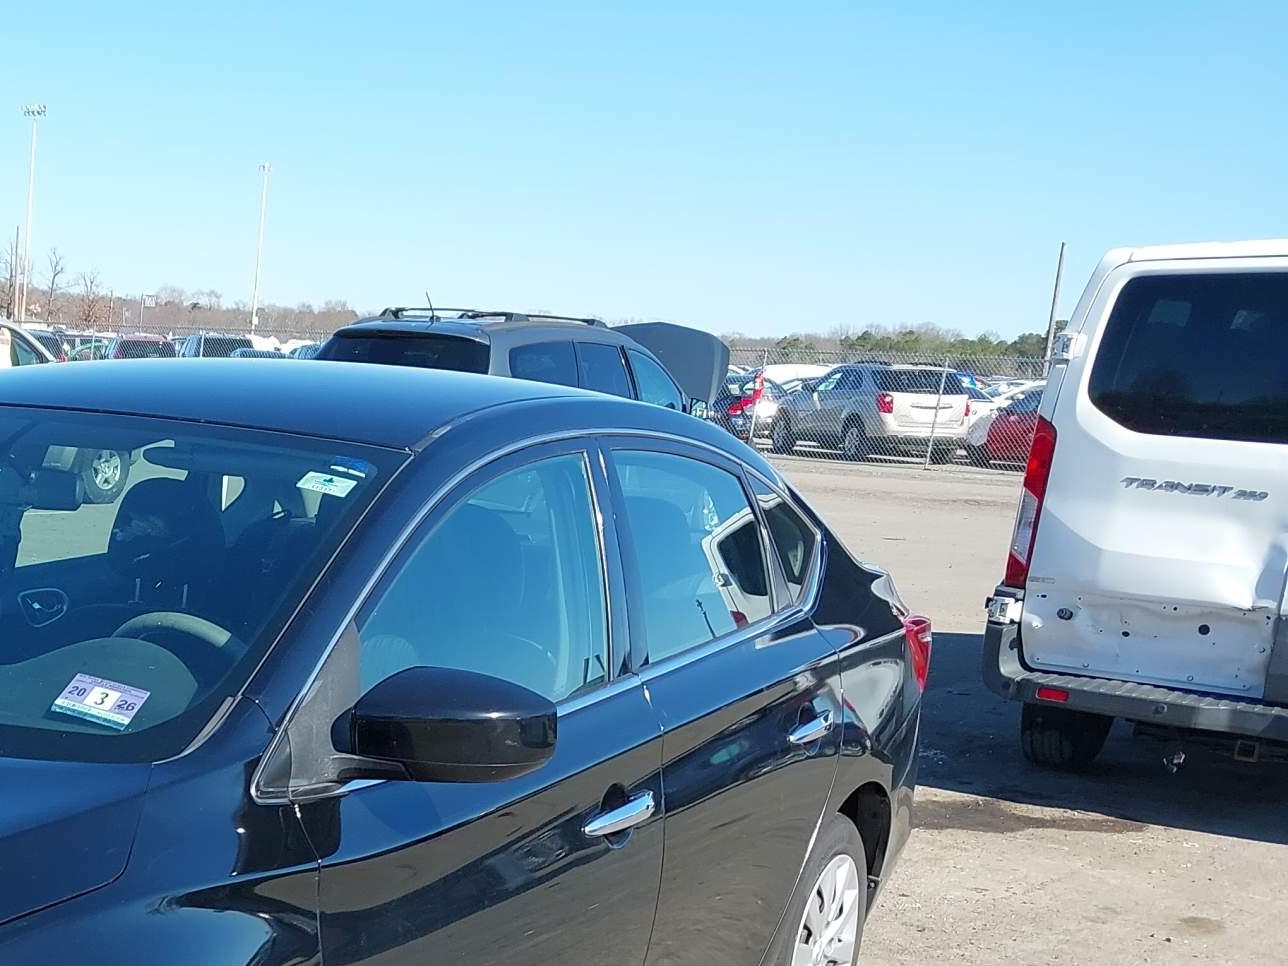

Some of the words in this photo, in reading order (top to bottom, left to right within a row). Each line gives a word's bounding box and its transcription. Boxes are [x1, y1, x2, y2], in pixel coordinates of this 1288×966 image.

[1120, 477, 1234, 497] TRANSIT
[68, 686, 87, 697] 20
[94, 692, 109, 706] 3
[117, 699, 138, 712] 26
